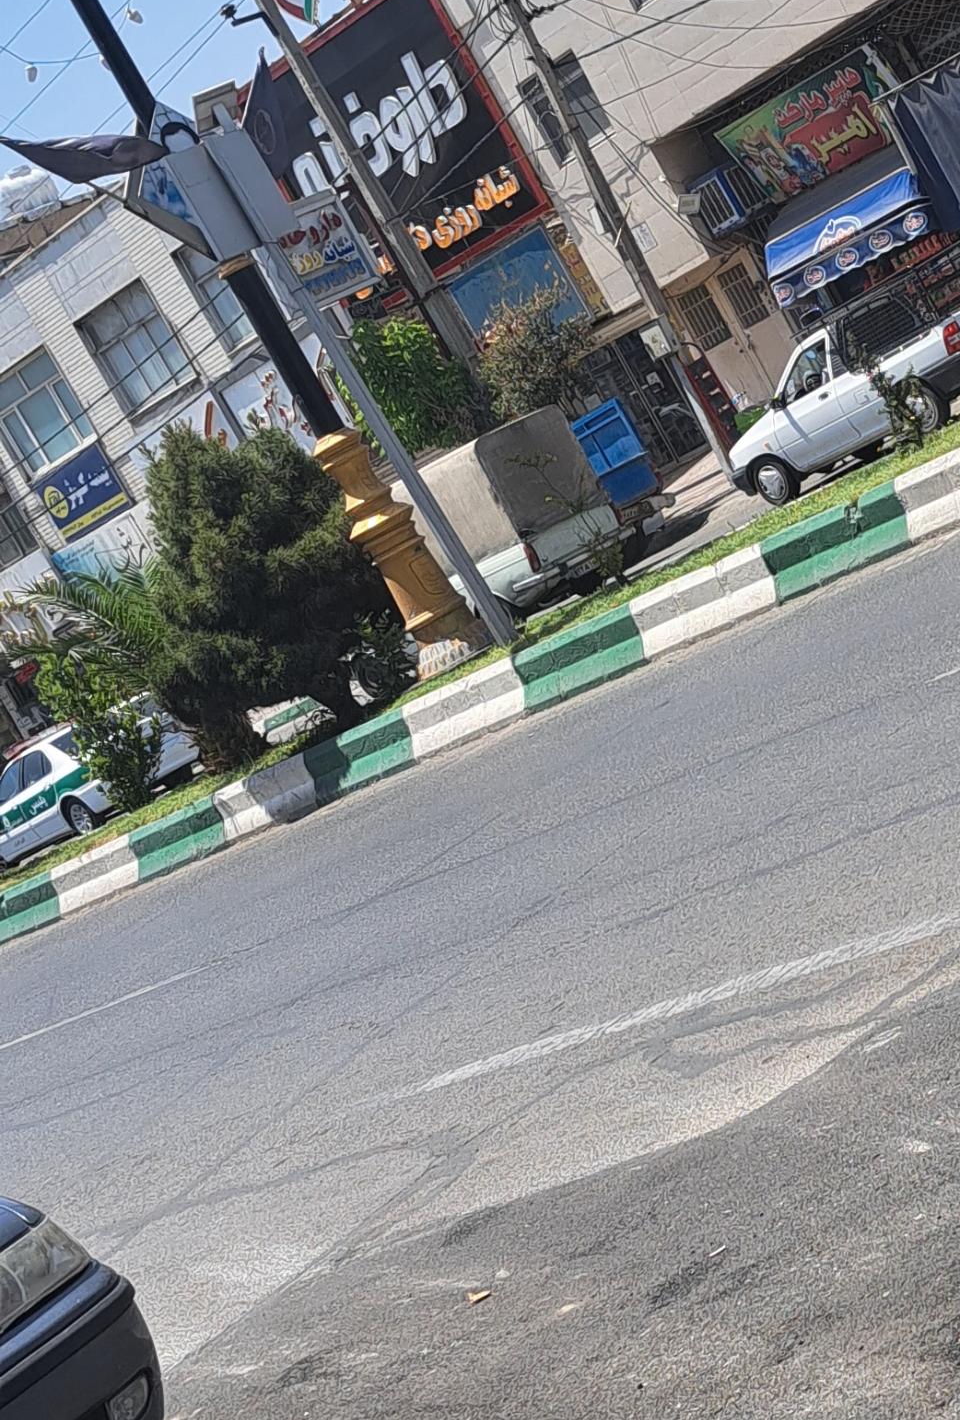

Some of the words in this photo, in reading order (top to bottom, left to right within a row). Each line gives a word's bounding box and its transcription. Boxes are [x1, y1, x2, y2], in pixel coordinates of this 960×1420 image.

[773, 89, 827, 128] مارکت
[822, 66, 861, 110] هایپر
[293, 50, 467, 198] داروخنه
[810, 101, 878, 166] امیر
[473, 165, 521, 212] شبانه
[323, 235, 357, 264] شبانه
[432, 204, 484, 250] روزی
